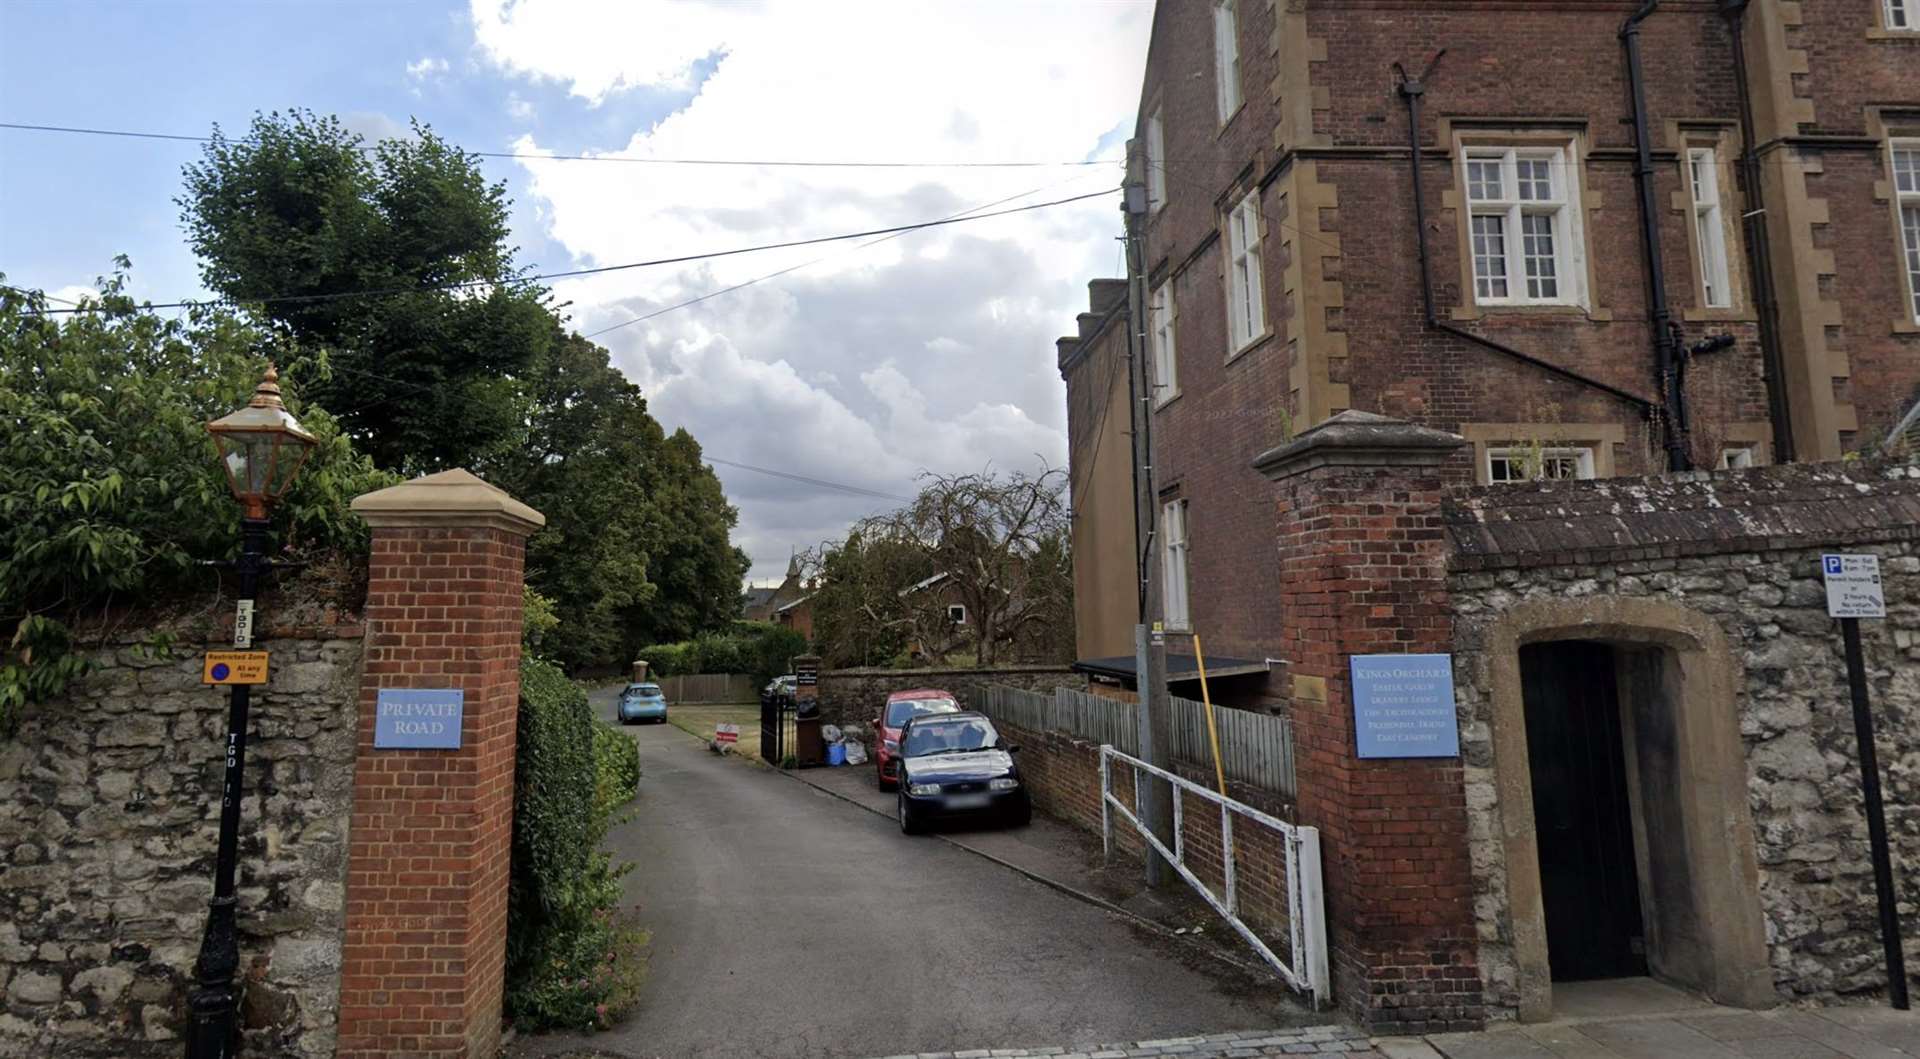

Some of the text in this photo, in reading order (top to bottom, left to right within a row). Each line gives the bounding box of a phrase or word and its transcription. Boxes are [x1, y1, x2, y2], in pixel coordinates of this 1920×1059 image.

[1828, 558, 1839, 572] P
[382, 702, 457, 716] PRIVATE
[395, 720, 445, 734] ROAD
